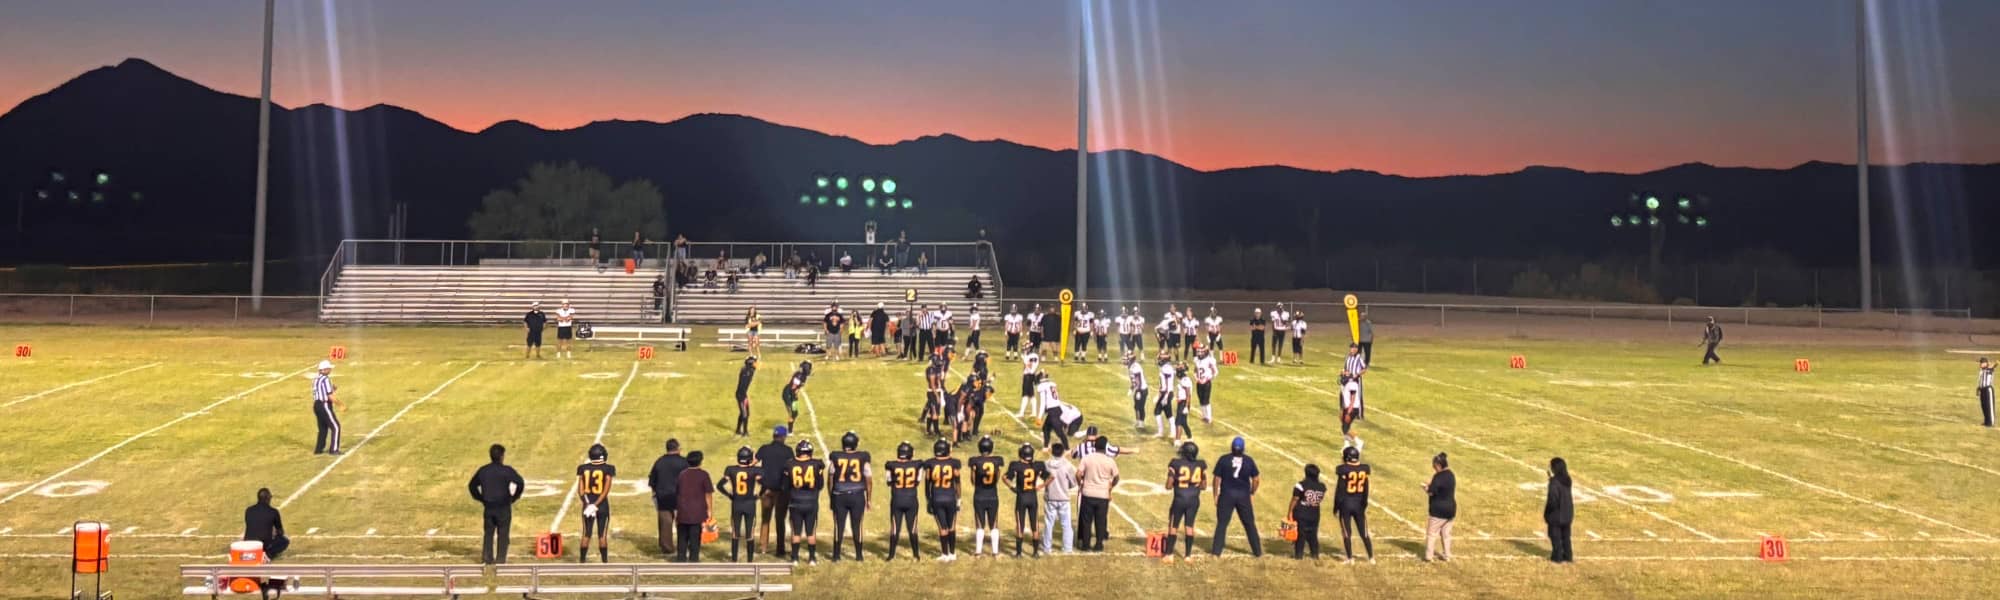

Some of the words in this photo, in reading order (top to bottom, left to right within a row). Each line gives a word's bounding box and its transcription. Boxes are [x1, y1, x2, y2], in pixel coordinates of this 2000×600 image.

[906, 289, 916, 300] 2
[331, 348, 343, 359] 40
[640, 347, 651, 359] 50
[1225, 352, 1237, 364] 30
[1513, 357, 1524, 368] 20
[792, 466, 815, 488] 64
[838, 459, 861, 482] 73
[894, 468, 916, 489] 32
[931, 465, 953, 488] 42
[982, 462, 994, 485] 3
[1178, 466, 1202, 488] 24
[1232, 458, 1243, 478] 7
[583, 470, 604, 494] 13
[735, 471, 748, 495] 6
[1023, 468, 1035, 491] 2
[1347, 471, 1366, 493] 22
[540, 536, 559, 555] 50
[1150, 536, 1168, 554] 40
[1766, 539, 1785, 557] 30
